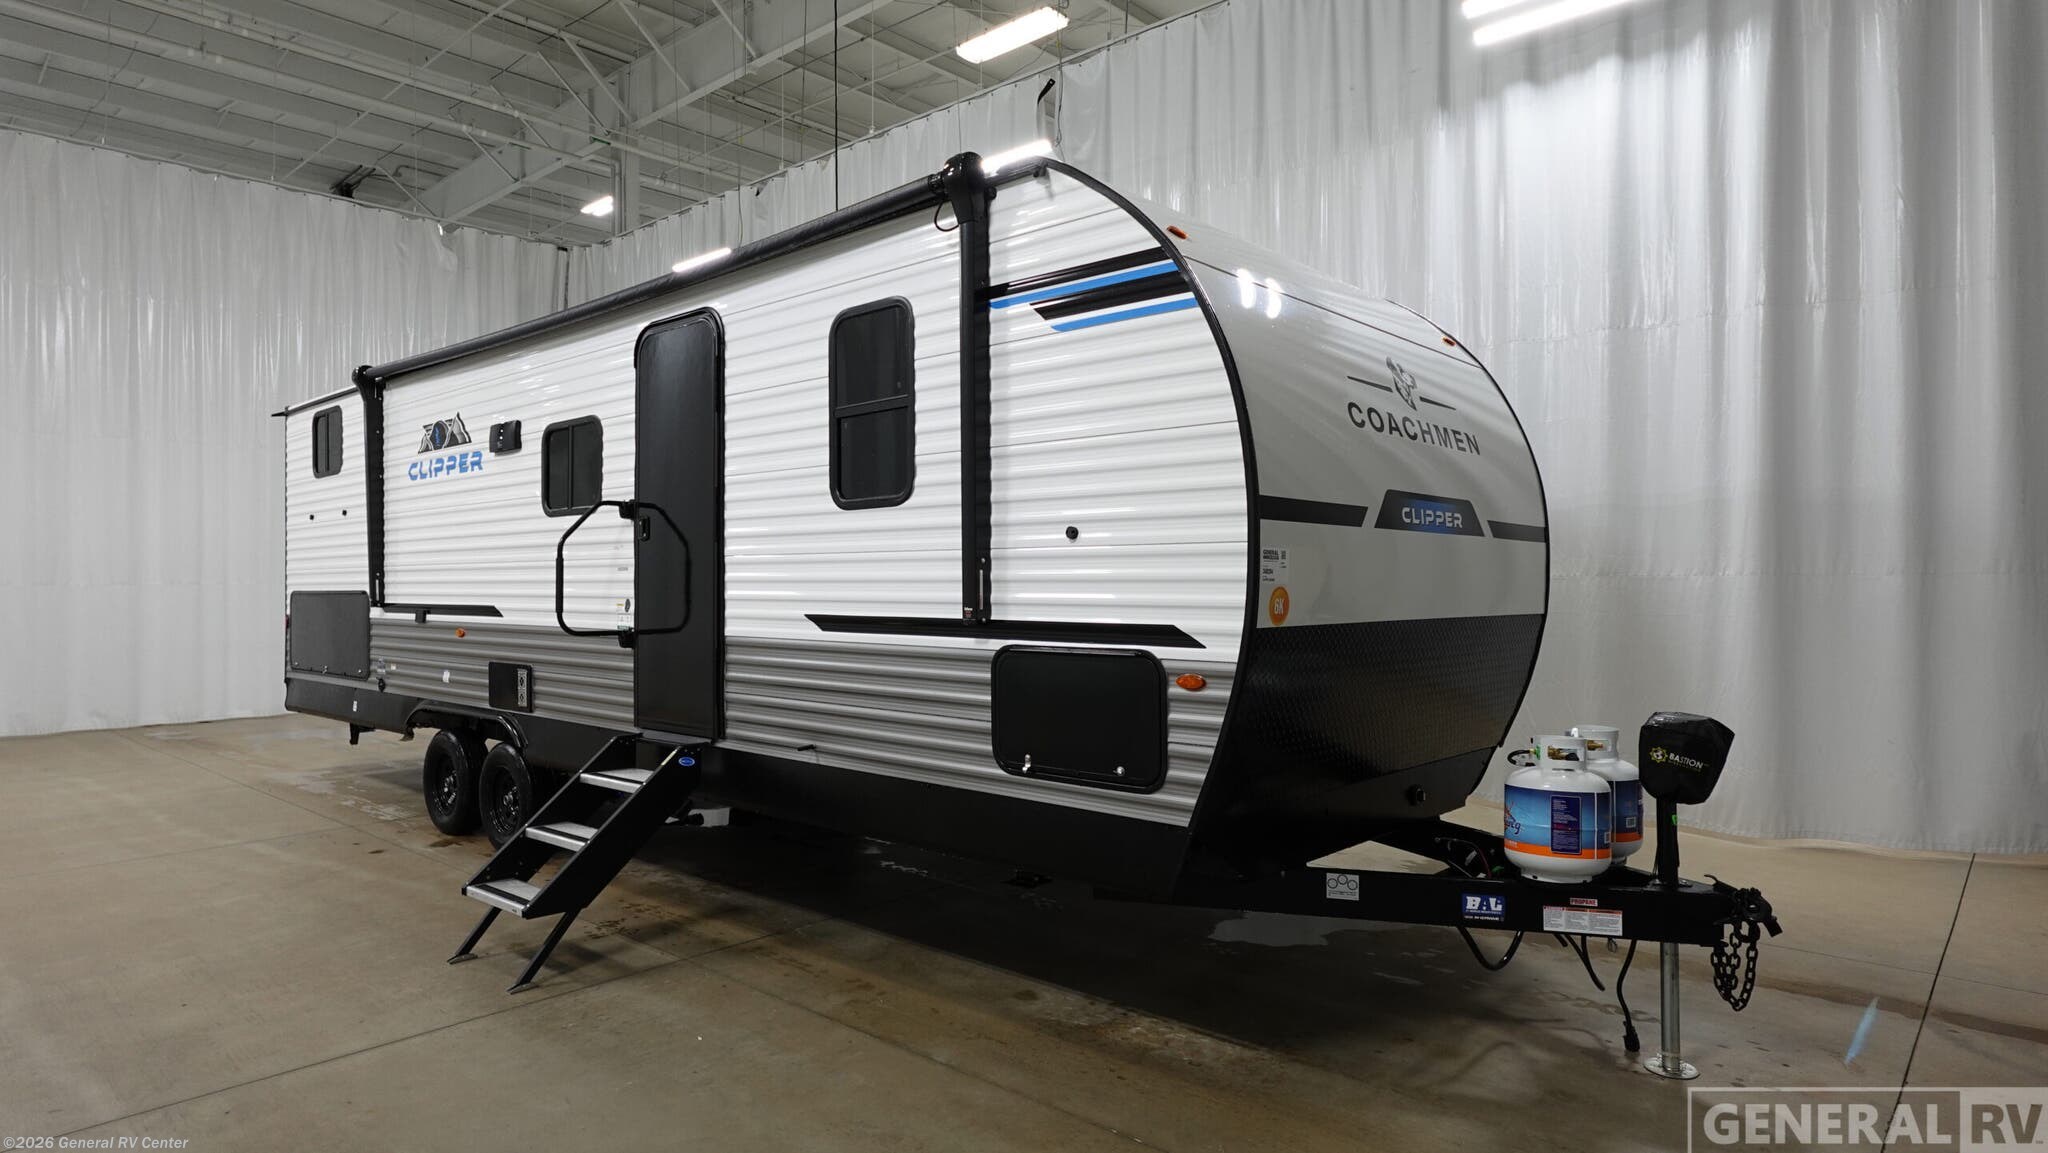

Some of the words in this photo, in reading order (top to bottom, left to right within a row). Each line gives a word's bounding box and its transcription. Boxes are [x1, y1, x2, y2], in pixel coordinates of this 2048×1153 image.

[1347, 401, 1481, 456] COACHMEN
[408, 451, 483, 481] CLIPPER
[1402, 507, 1463, 529] CLIPPER
[1669, 752, 1704, 769] BASTION
